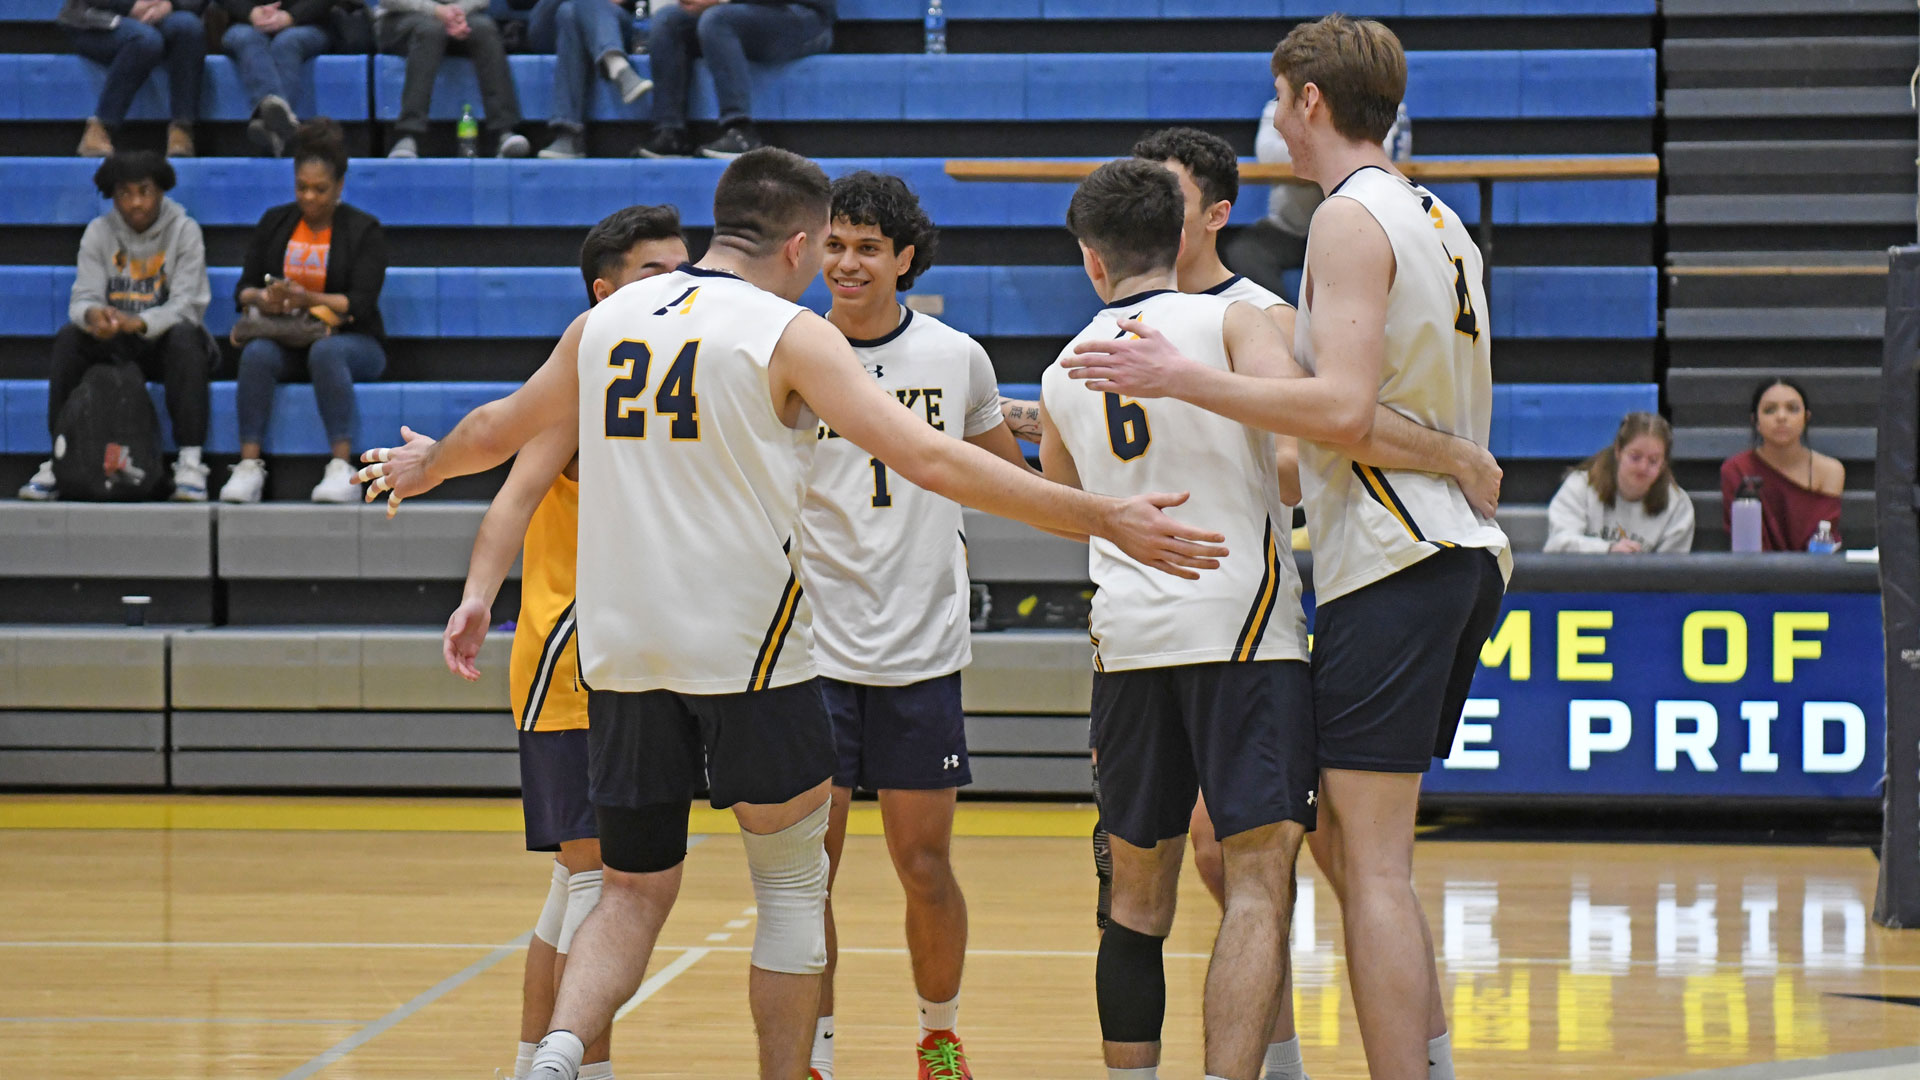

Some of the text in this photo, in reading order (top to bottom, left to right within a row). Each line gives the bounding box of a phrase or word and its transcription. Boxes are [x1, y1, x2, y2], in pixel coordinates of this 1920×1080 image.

[604, 337, 702, 442] 24
[1102, 390, 1153, 464] 6
[869, 456, 893, 508] 1
[1479, 609, 1830, 684] ME OF
[1568, 698, 1867, 774] PRID
